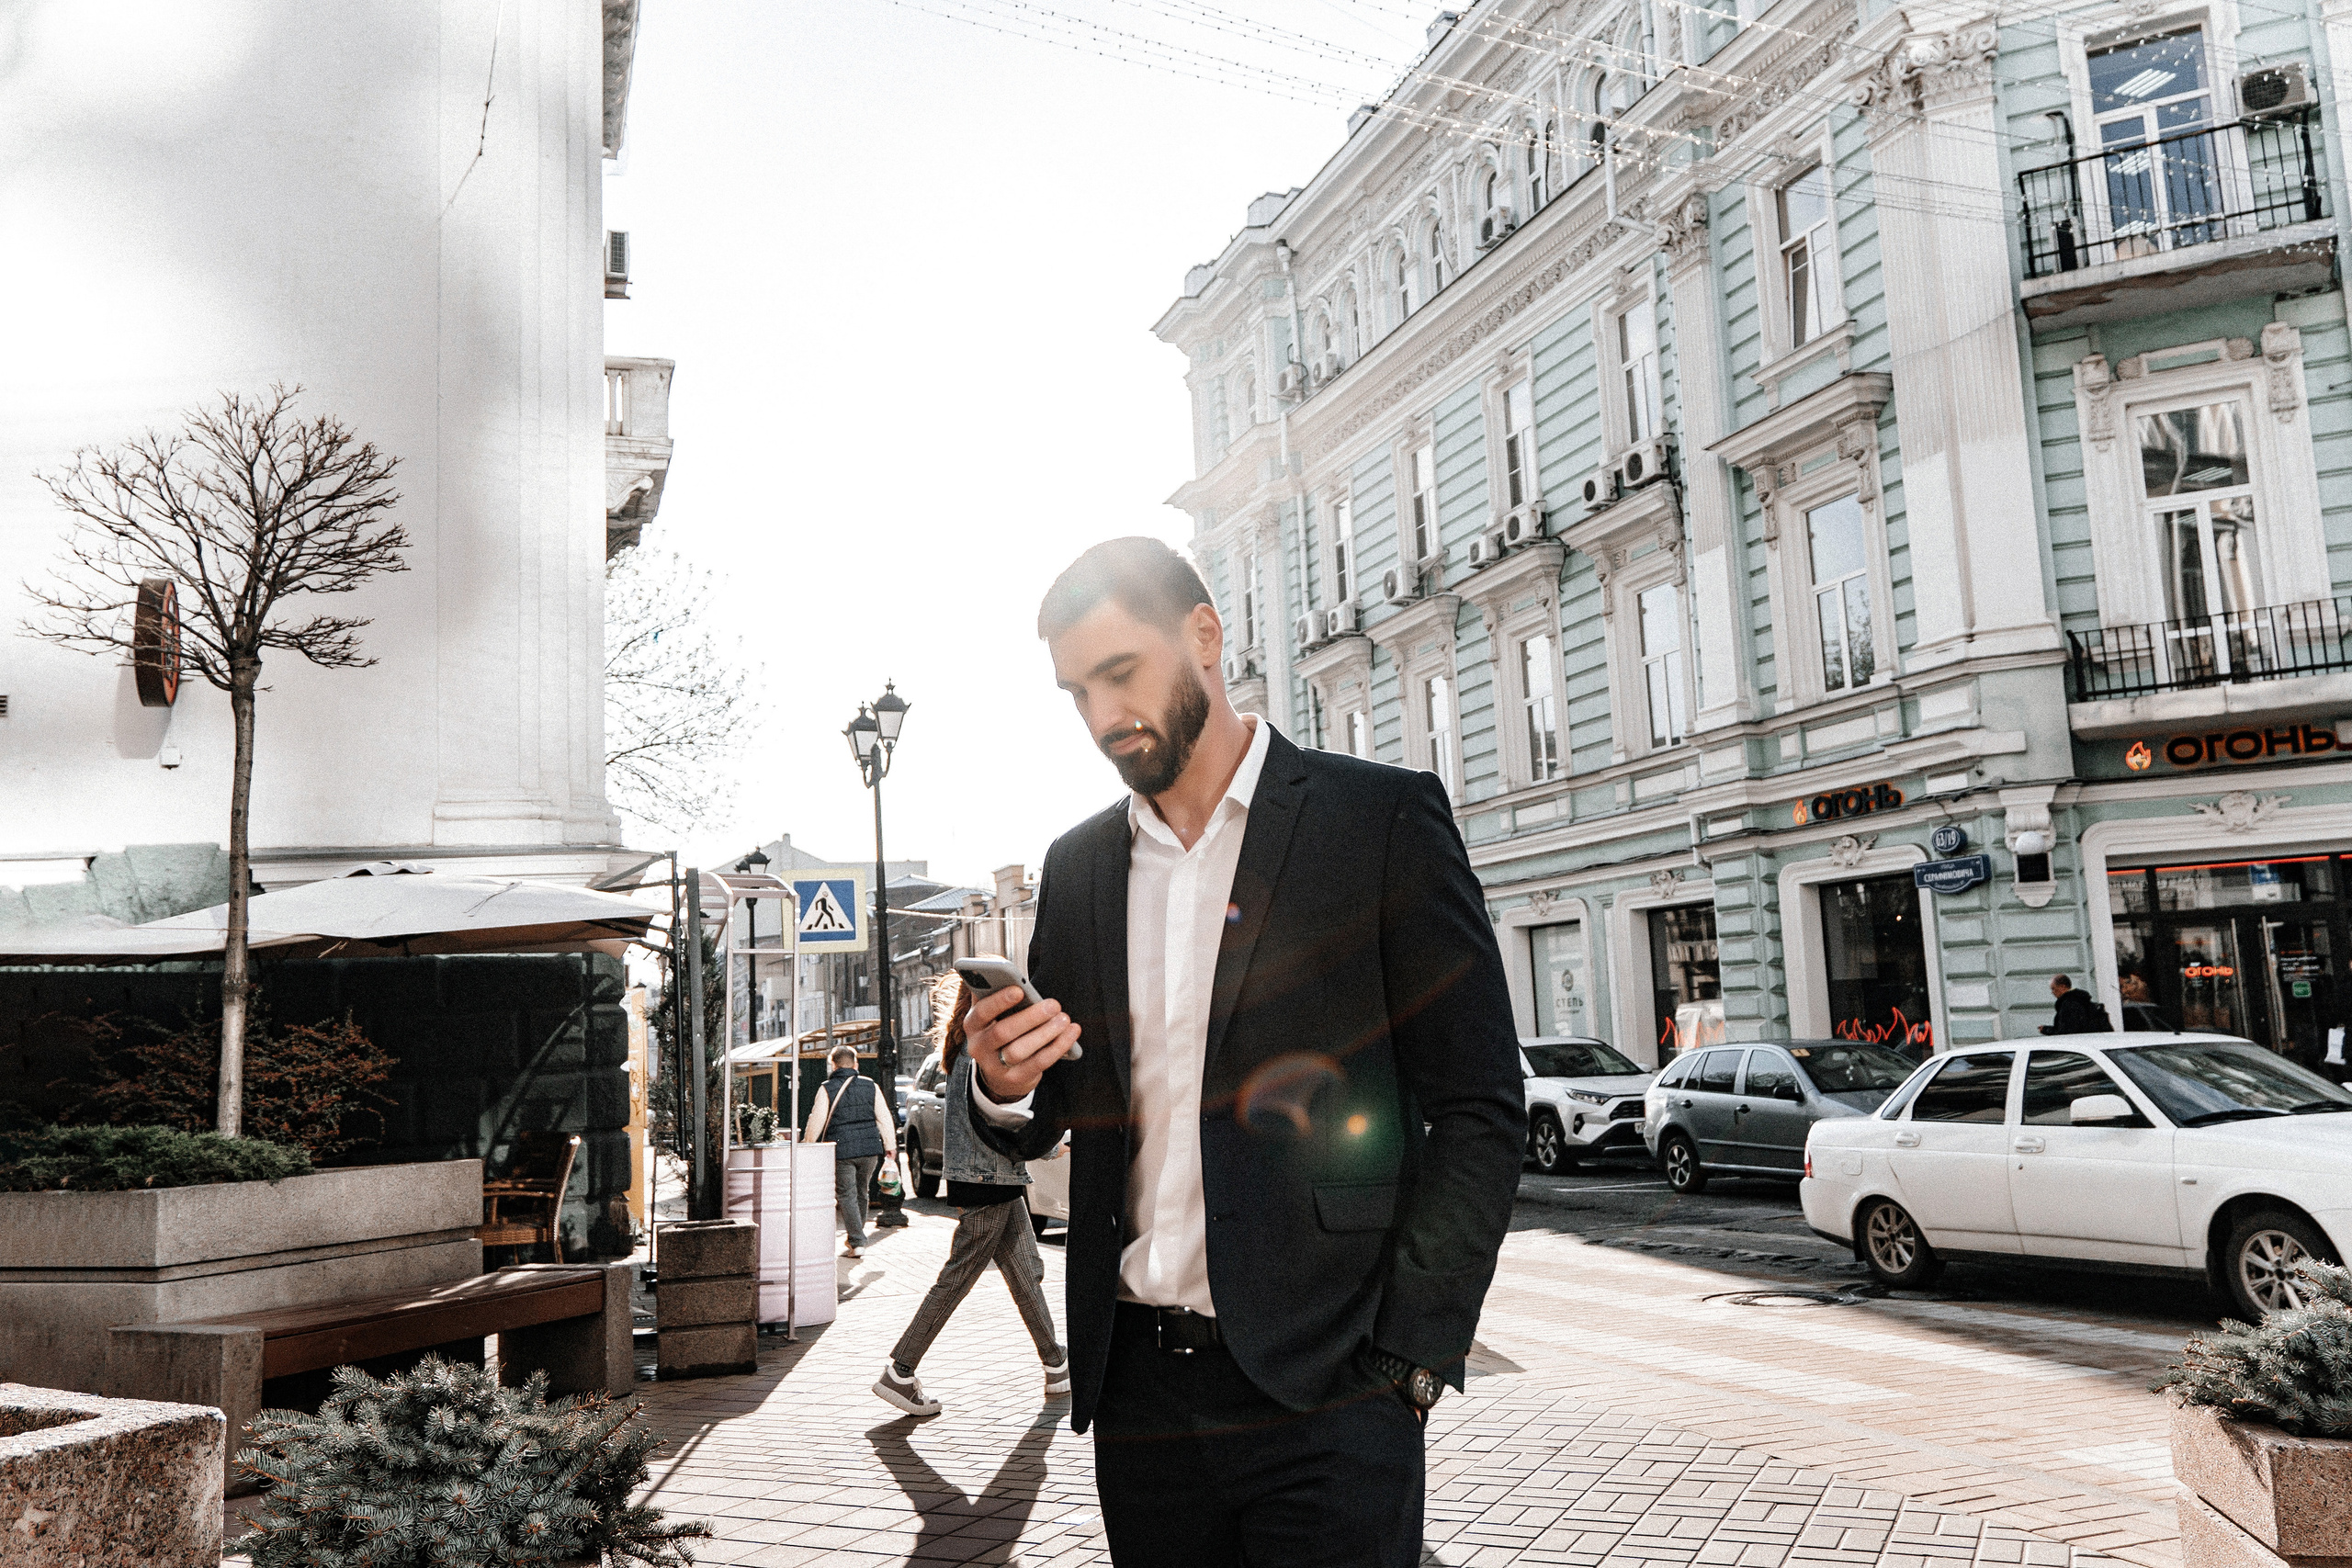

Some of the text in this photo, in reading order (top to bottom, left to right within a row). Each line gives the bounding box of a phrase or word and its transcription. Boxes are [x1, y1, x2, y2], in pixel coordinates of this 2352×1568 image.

[2166, 724, 2336, 765] ОГОНЬ
[1812, 784, 1901, 819] ОГОНЬ
[1936, 831, 1956, 848] 63/19
[1924, 868, 1973, 882] СЕРАФИМОВИЧА
[1556, 998, 1583, 1007] СТЕПЬ
